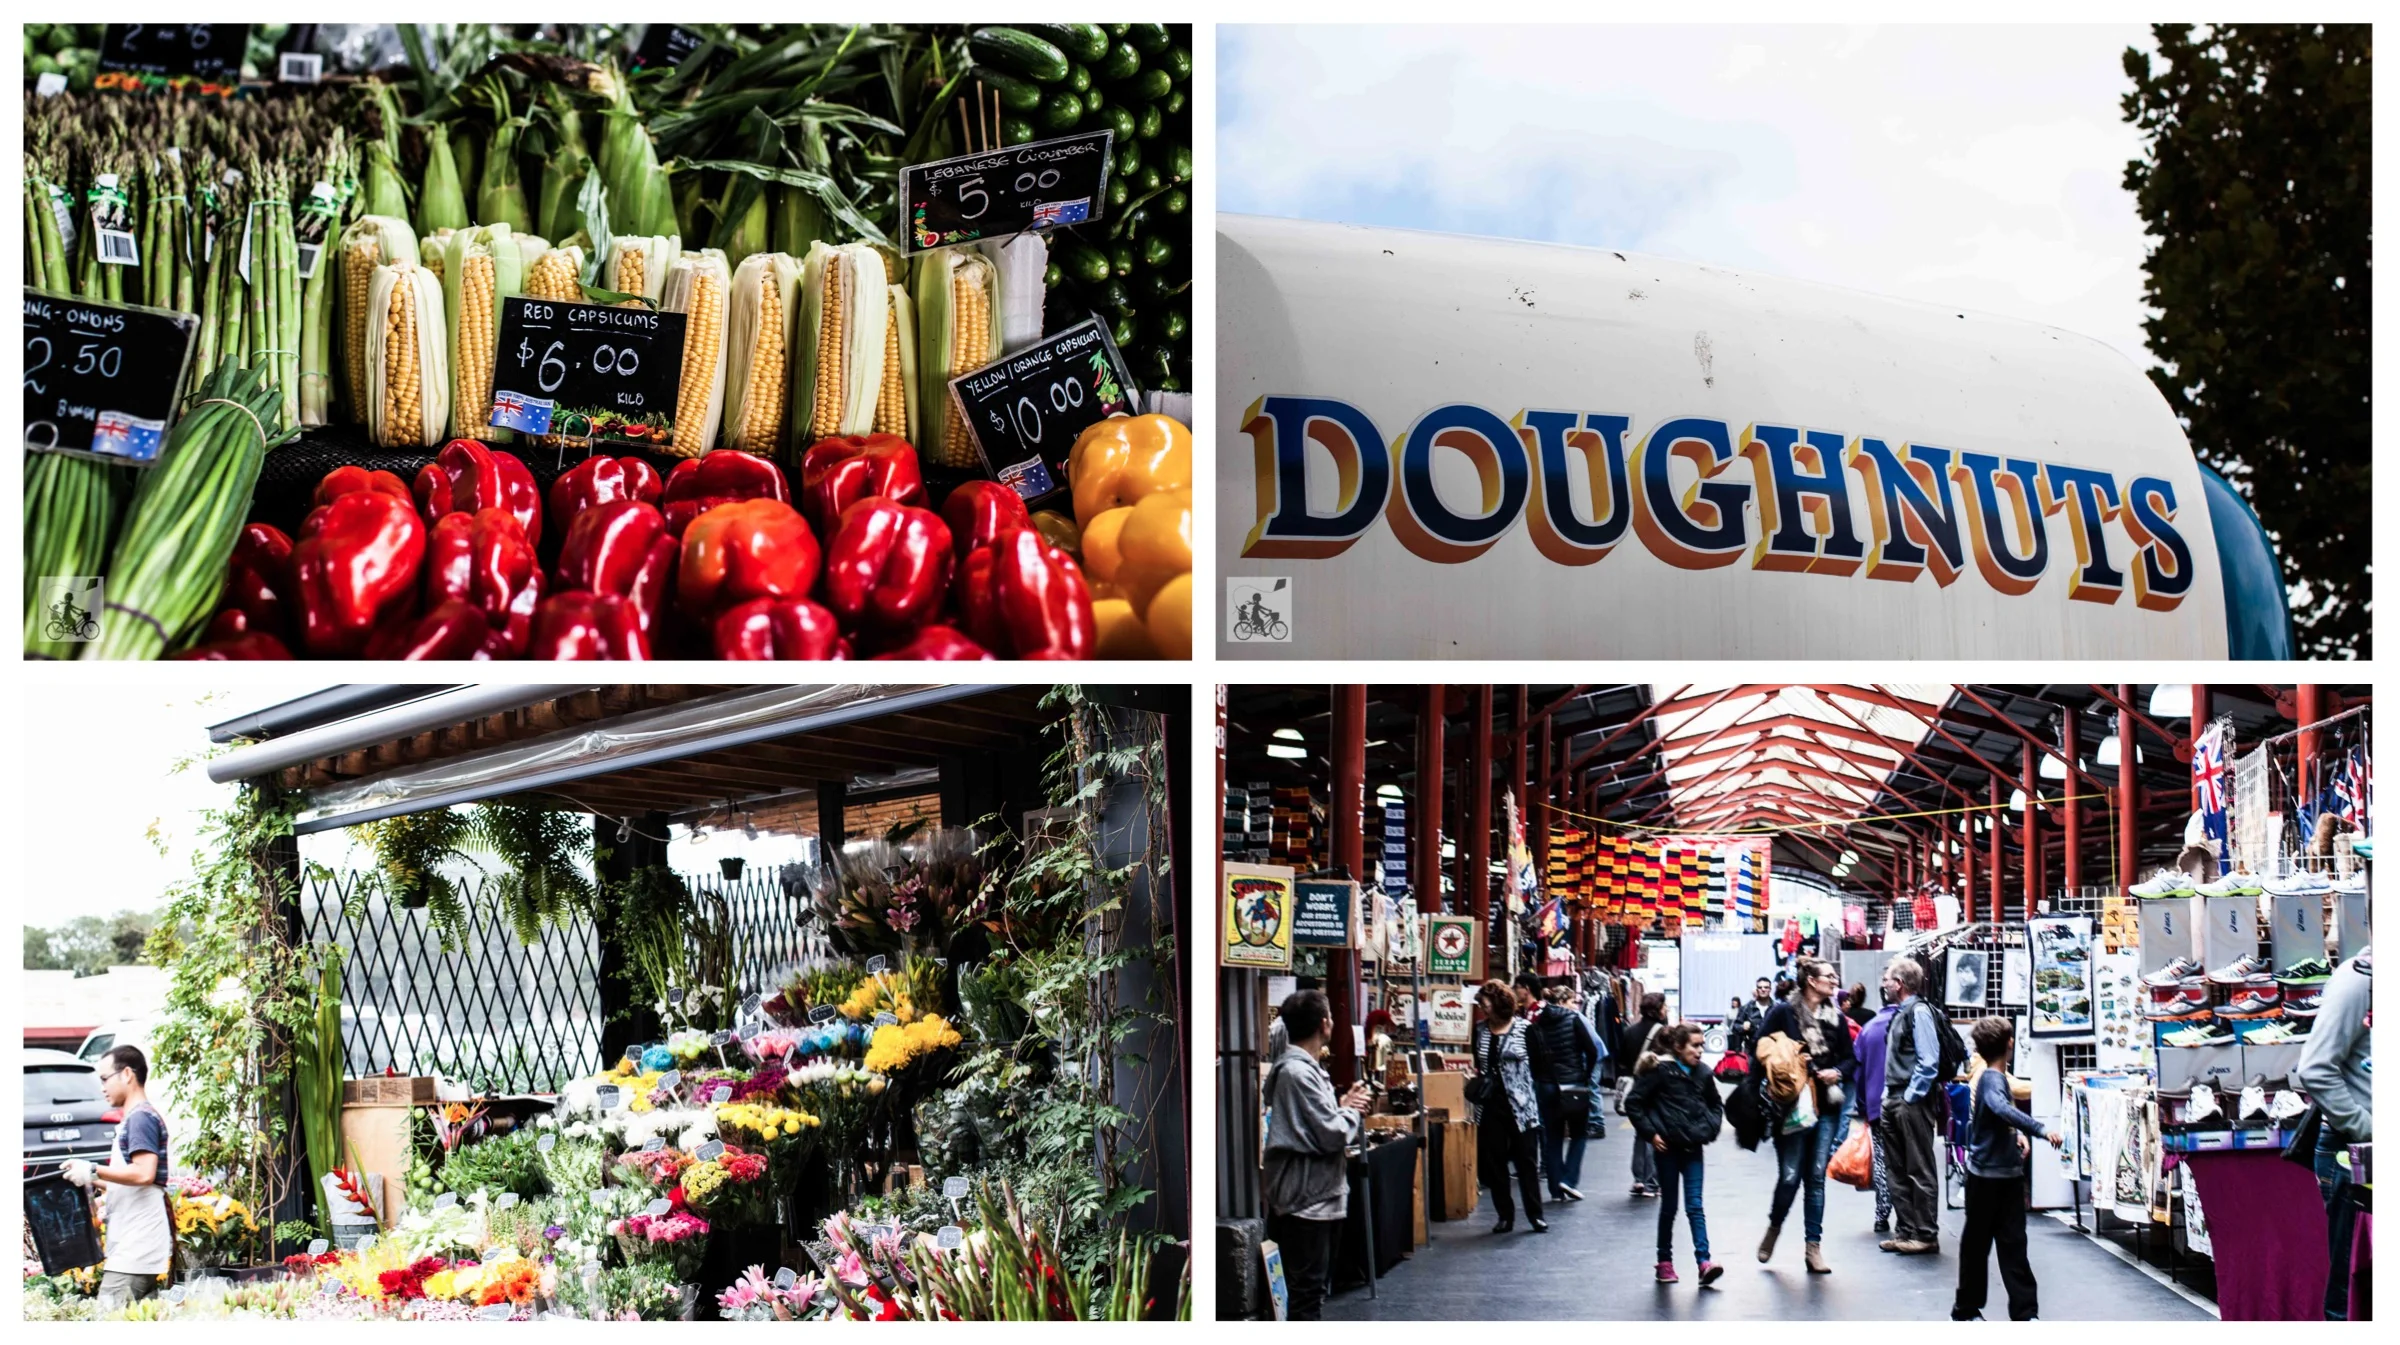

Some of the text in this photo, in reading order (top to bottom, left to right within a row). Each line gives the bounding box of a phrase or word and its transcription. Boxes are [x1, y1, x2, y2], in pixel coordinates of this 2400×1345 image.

[924, 155, 1009, 181] LEBANESE
[523, 302, 659, 330] RED CAPSICUMS
[1055, 329, 1101, 355] CAPSICUM
[516, 336, 640, 393] $6.00
[525, 397, 551, 406] AUSTRALIAN
[617, 392, 644, 406] KILO
[1240, 394, 2195, 612] DOUGHNUTS
[1309, 892, 1335, 902] DON'T
[1434, 958, 1467, 967] TEXACO
[1434, 1010, 1467, 1021] Mobiloil
